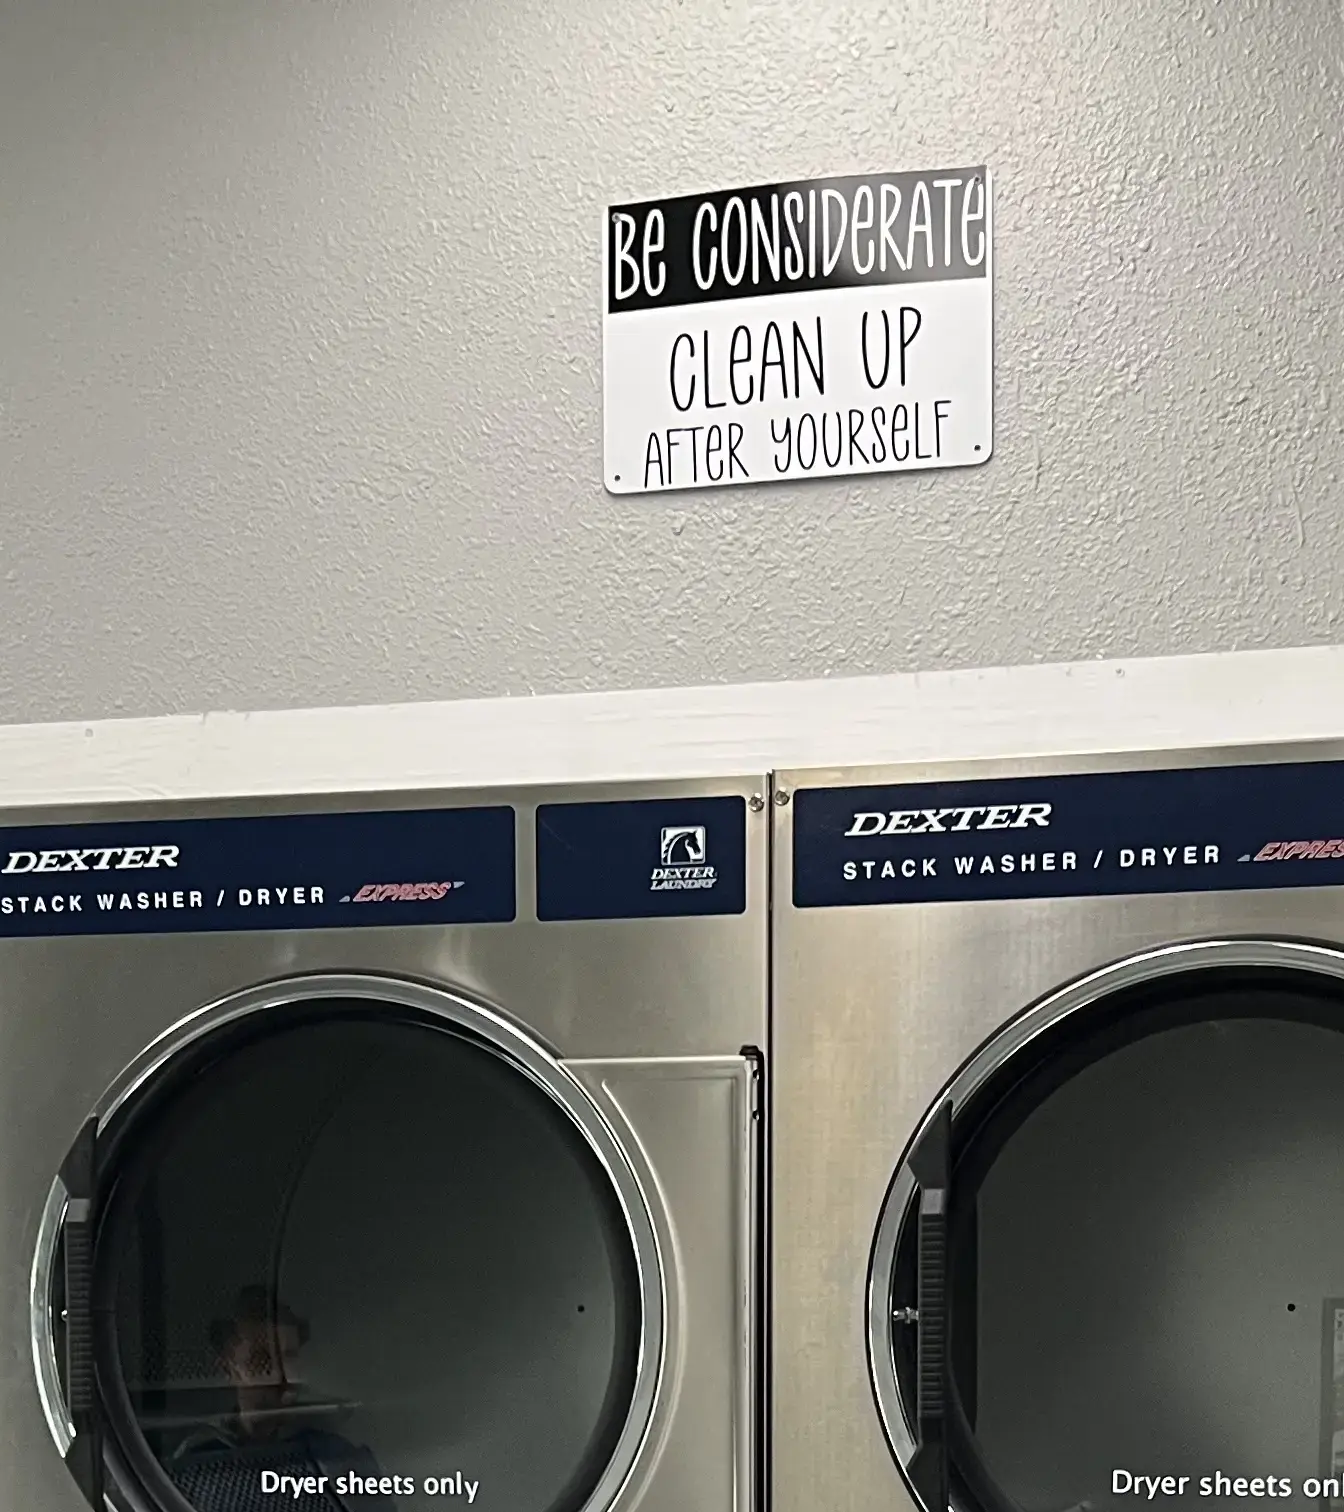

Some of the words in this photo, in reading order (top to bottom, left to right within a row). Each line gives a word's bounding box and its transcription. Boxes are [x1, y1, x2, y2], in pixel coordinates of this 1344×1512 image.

[861, 307, 922, 389] UP
[843, 803, 1052, 837] DEXTER
[0, 844, 180, 874] DEXTER
[651, 866, 716, 880] DEXTER
[842, 856, 939, 880] STACK
[954, 850, 1081, 876] WASHER
[1119, 844, 1222, 867] DRYER
[0, 895, 84, 913] STACK
[97, 891, 204, 910] WASHER
[238, 886, 326, 906] DRYER
[351, 880, 451, 902] EXPRESS
[261, 1471, 328, 1499] Dryer
[336, 1471, 416, 1495] sheets
[423, 1472, 479, 1503] only
[1112, 1470, 1190, 1500] Dryer
[1198, 1471, 1292, 1497] sheets
